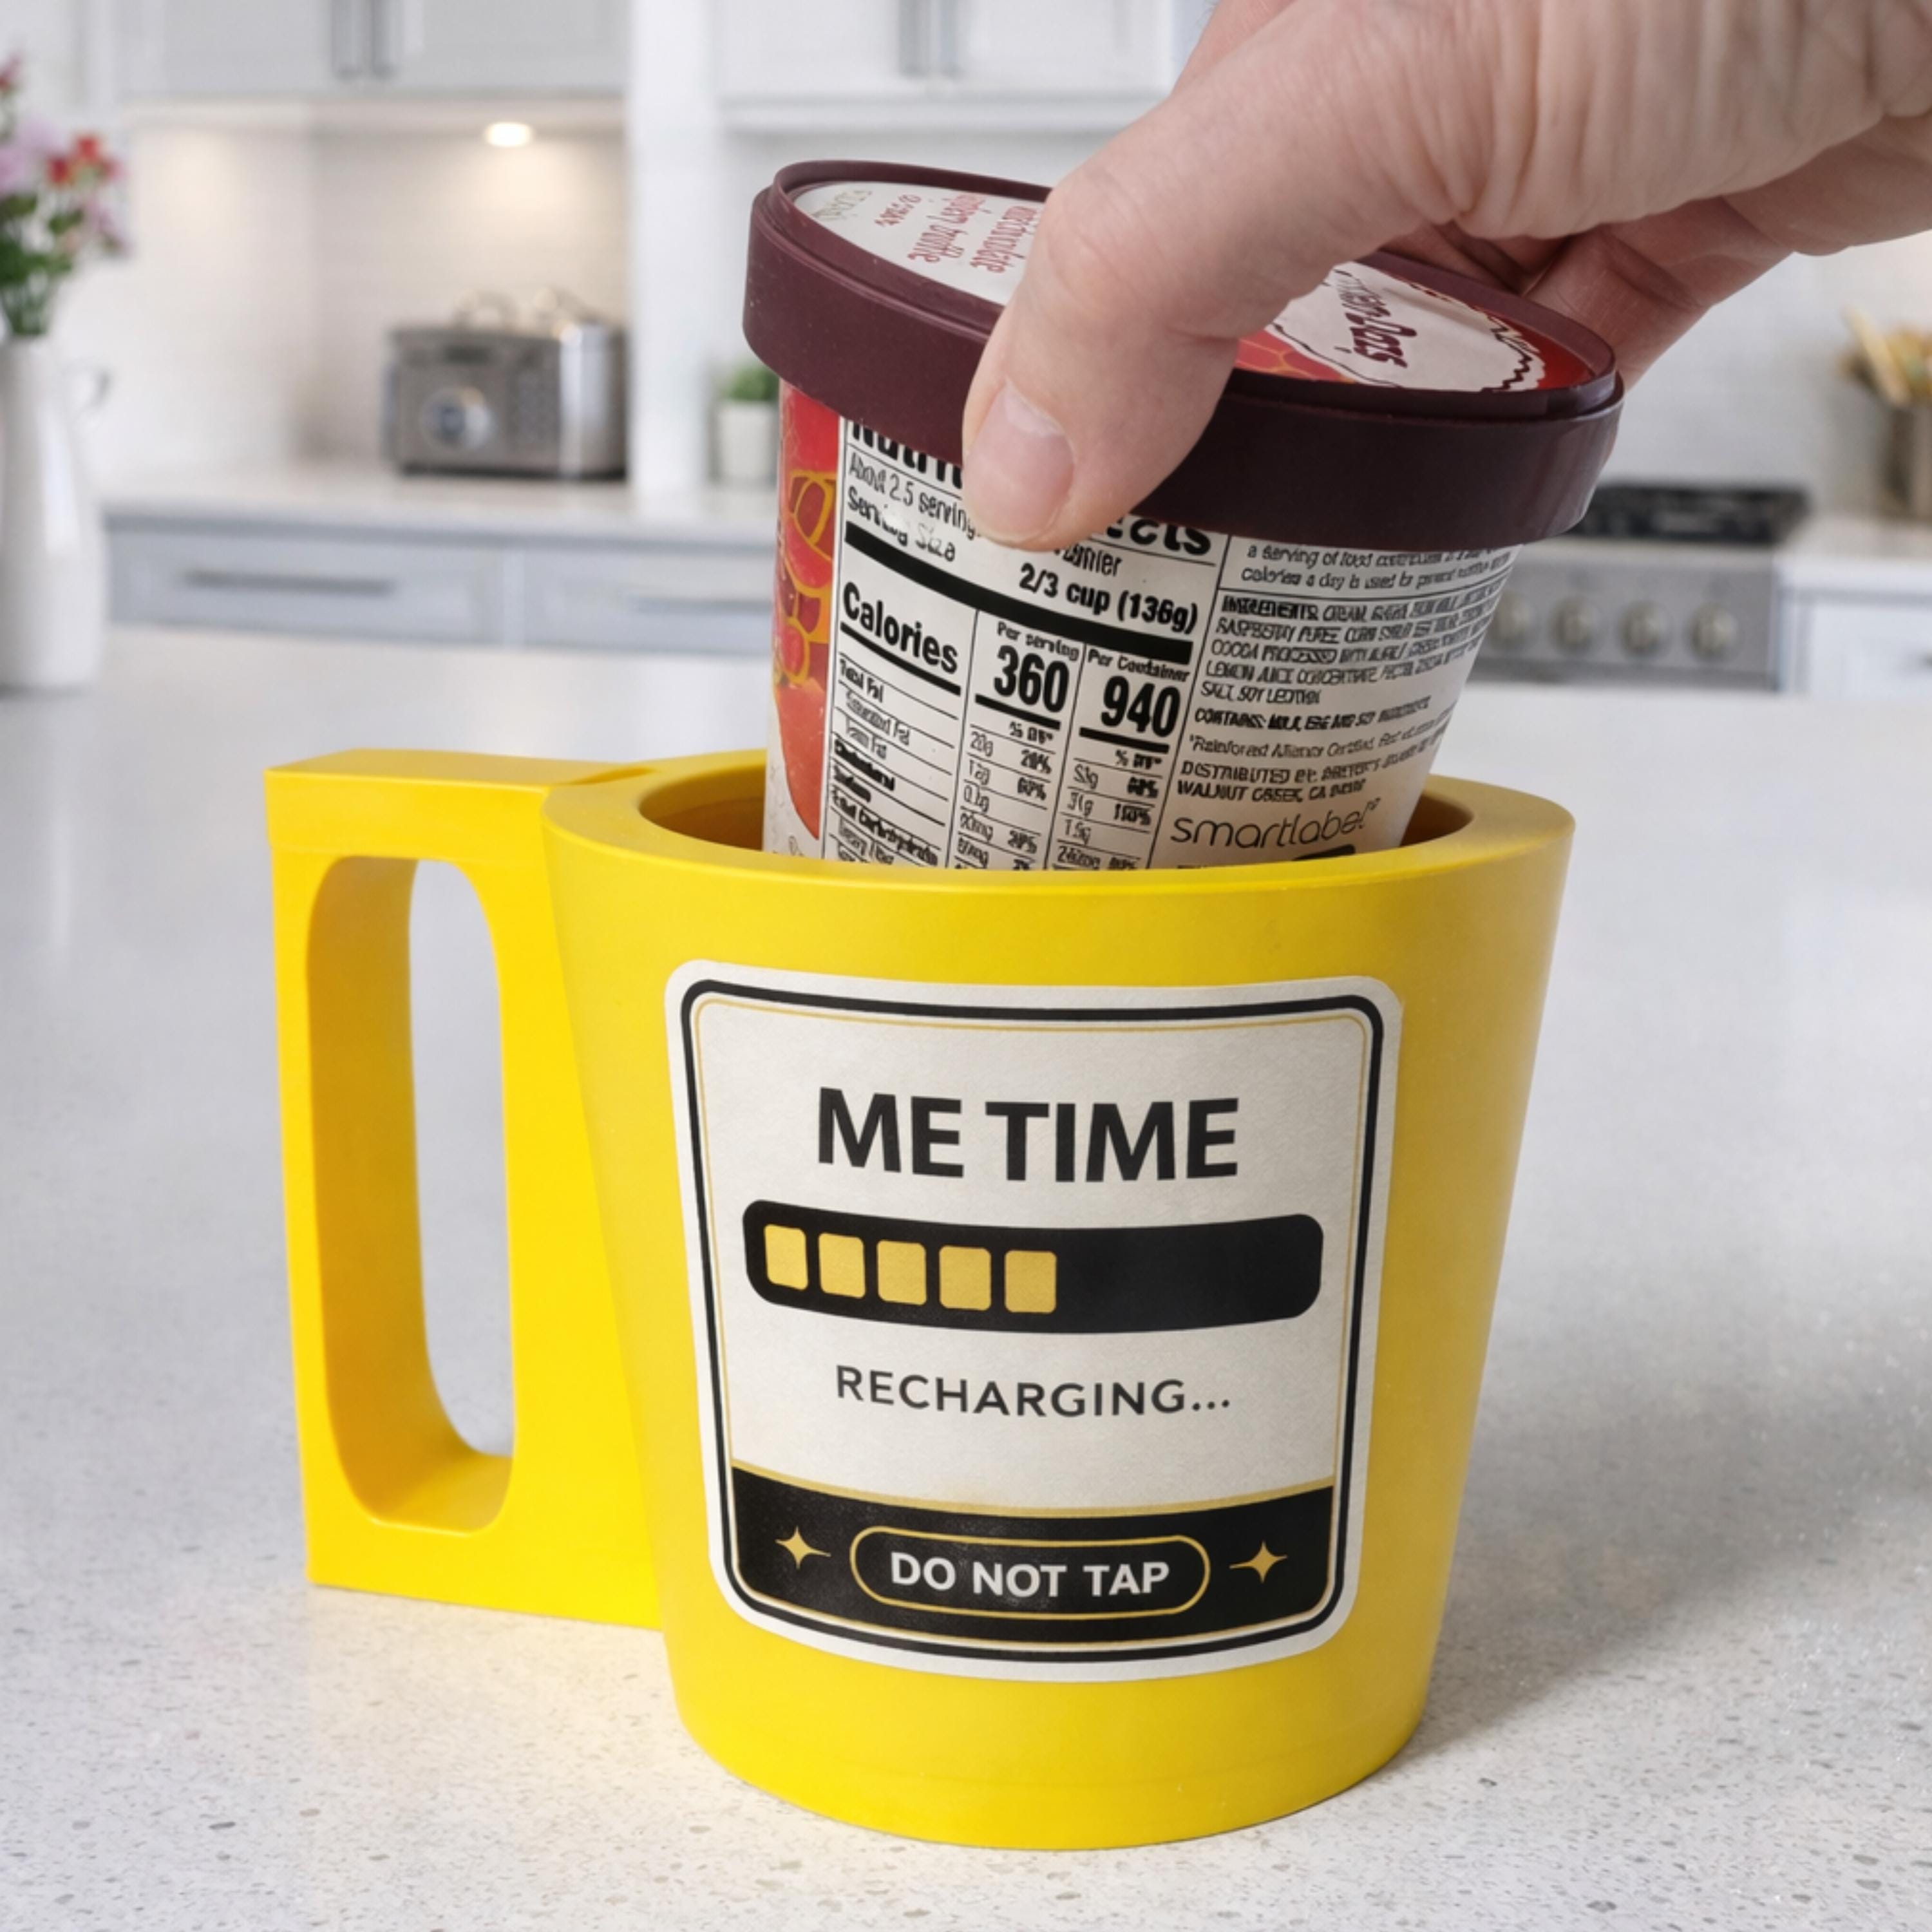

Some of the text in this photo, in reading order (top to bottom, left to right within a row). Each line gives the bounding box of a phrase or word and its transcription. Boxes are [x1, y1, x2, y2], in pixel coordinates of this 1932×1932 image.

[842, 581, 960, 676] Calories
[1019, 562, 1059, 598] 2/3
[1066, 582, 1112, 616] cup
[1118, 589, 1199, 635] (136g)
[996, 620, 1022, 641] Per
[1087, 648, 1114, 668] Per
[993, 645, 1070, 714] 360
[1101, 675, 1182, 738] 940
[817, 1086, 1240, 1184] ME TIME
[835, 1364, 1231, 1418] RECHARGING...
[891, 1551, 1170, 1598] DO NOT TAP
